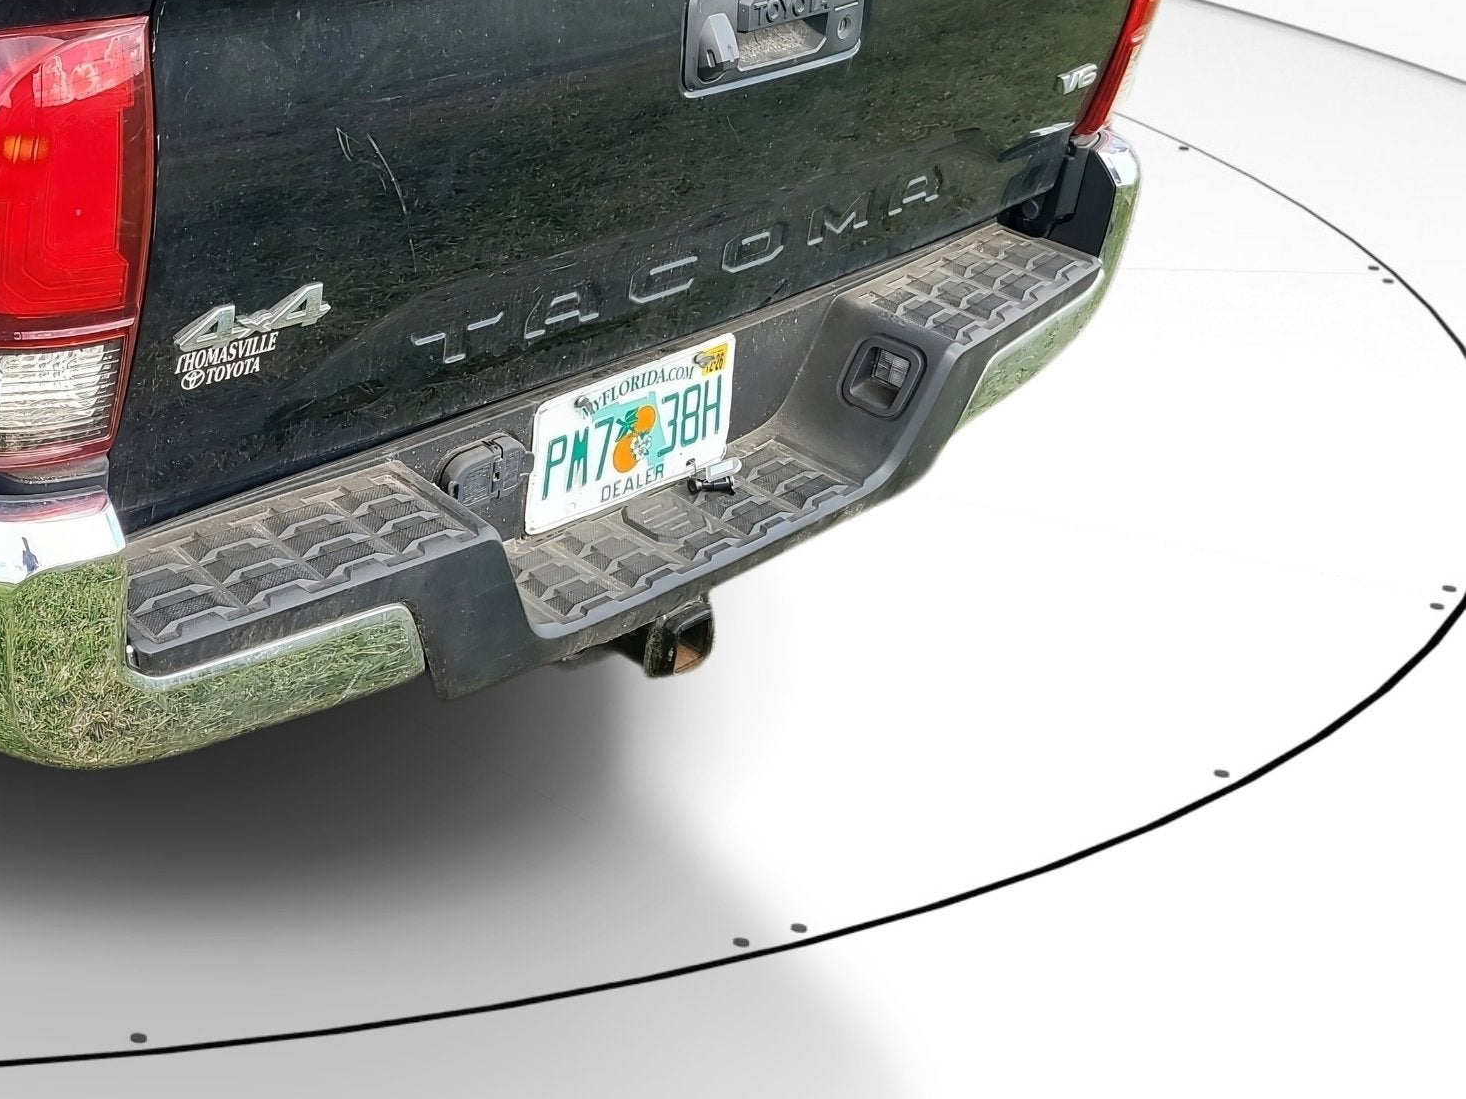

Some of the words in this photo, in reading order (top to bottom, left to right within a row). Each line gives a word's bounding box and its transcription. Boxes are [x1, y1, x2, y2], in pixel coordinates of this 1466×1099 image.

[1057, 63, 1098, 95] V6
[410, 166, 943, 364] TACOMA
[174, 331, 280, 375] THOMASVILLE
[205, 356, 261, 386] TOYOTA
[600, 463, 665, 503] DEALER
